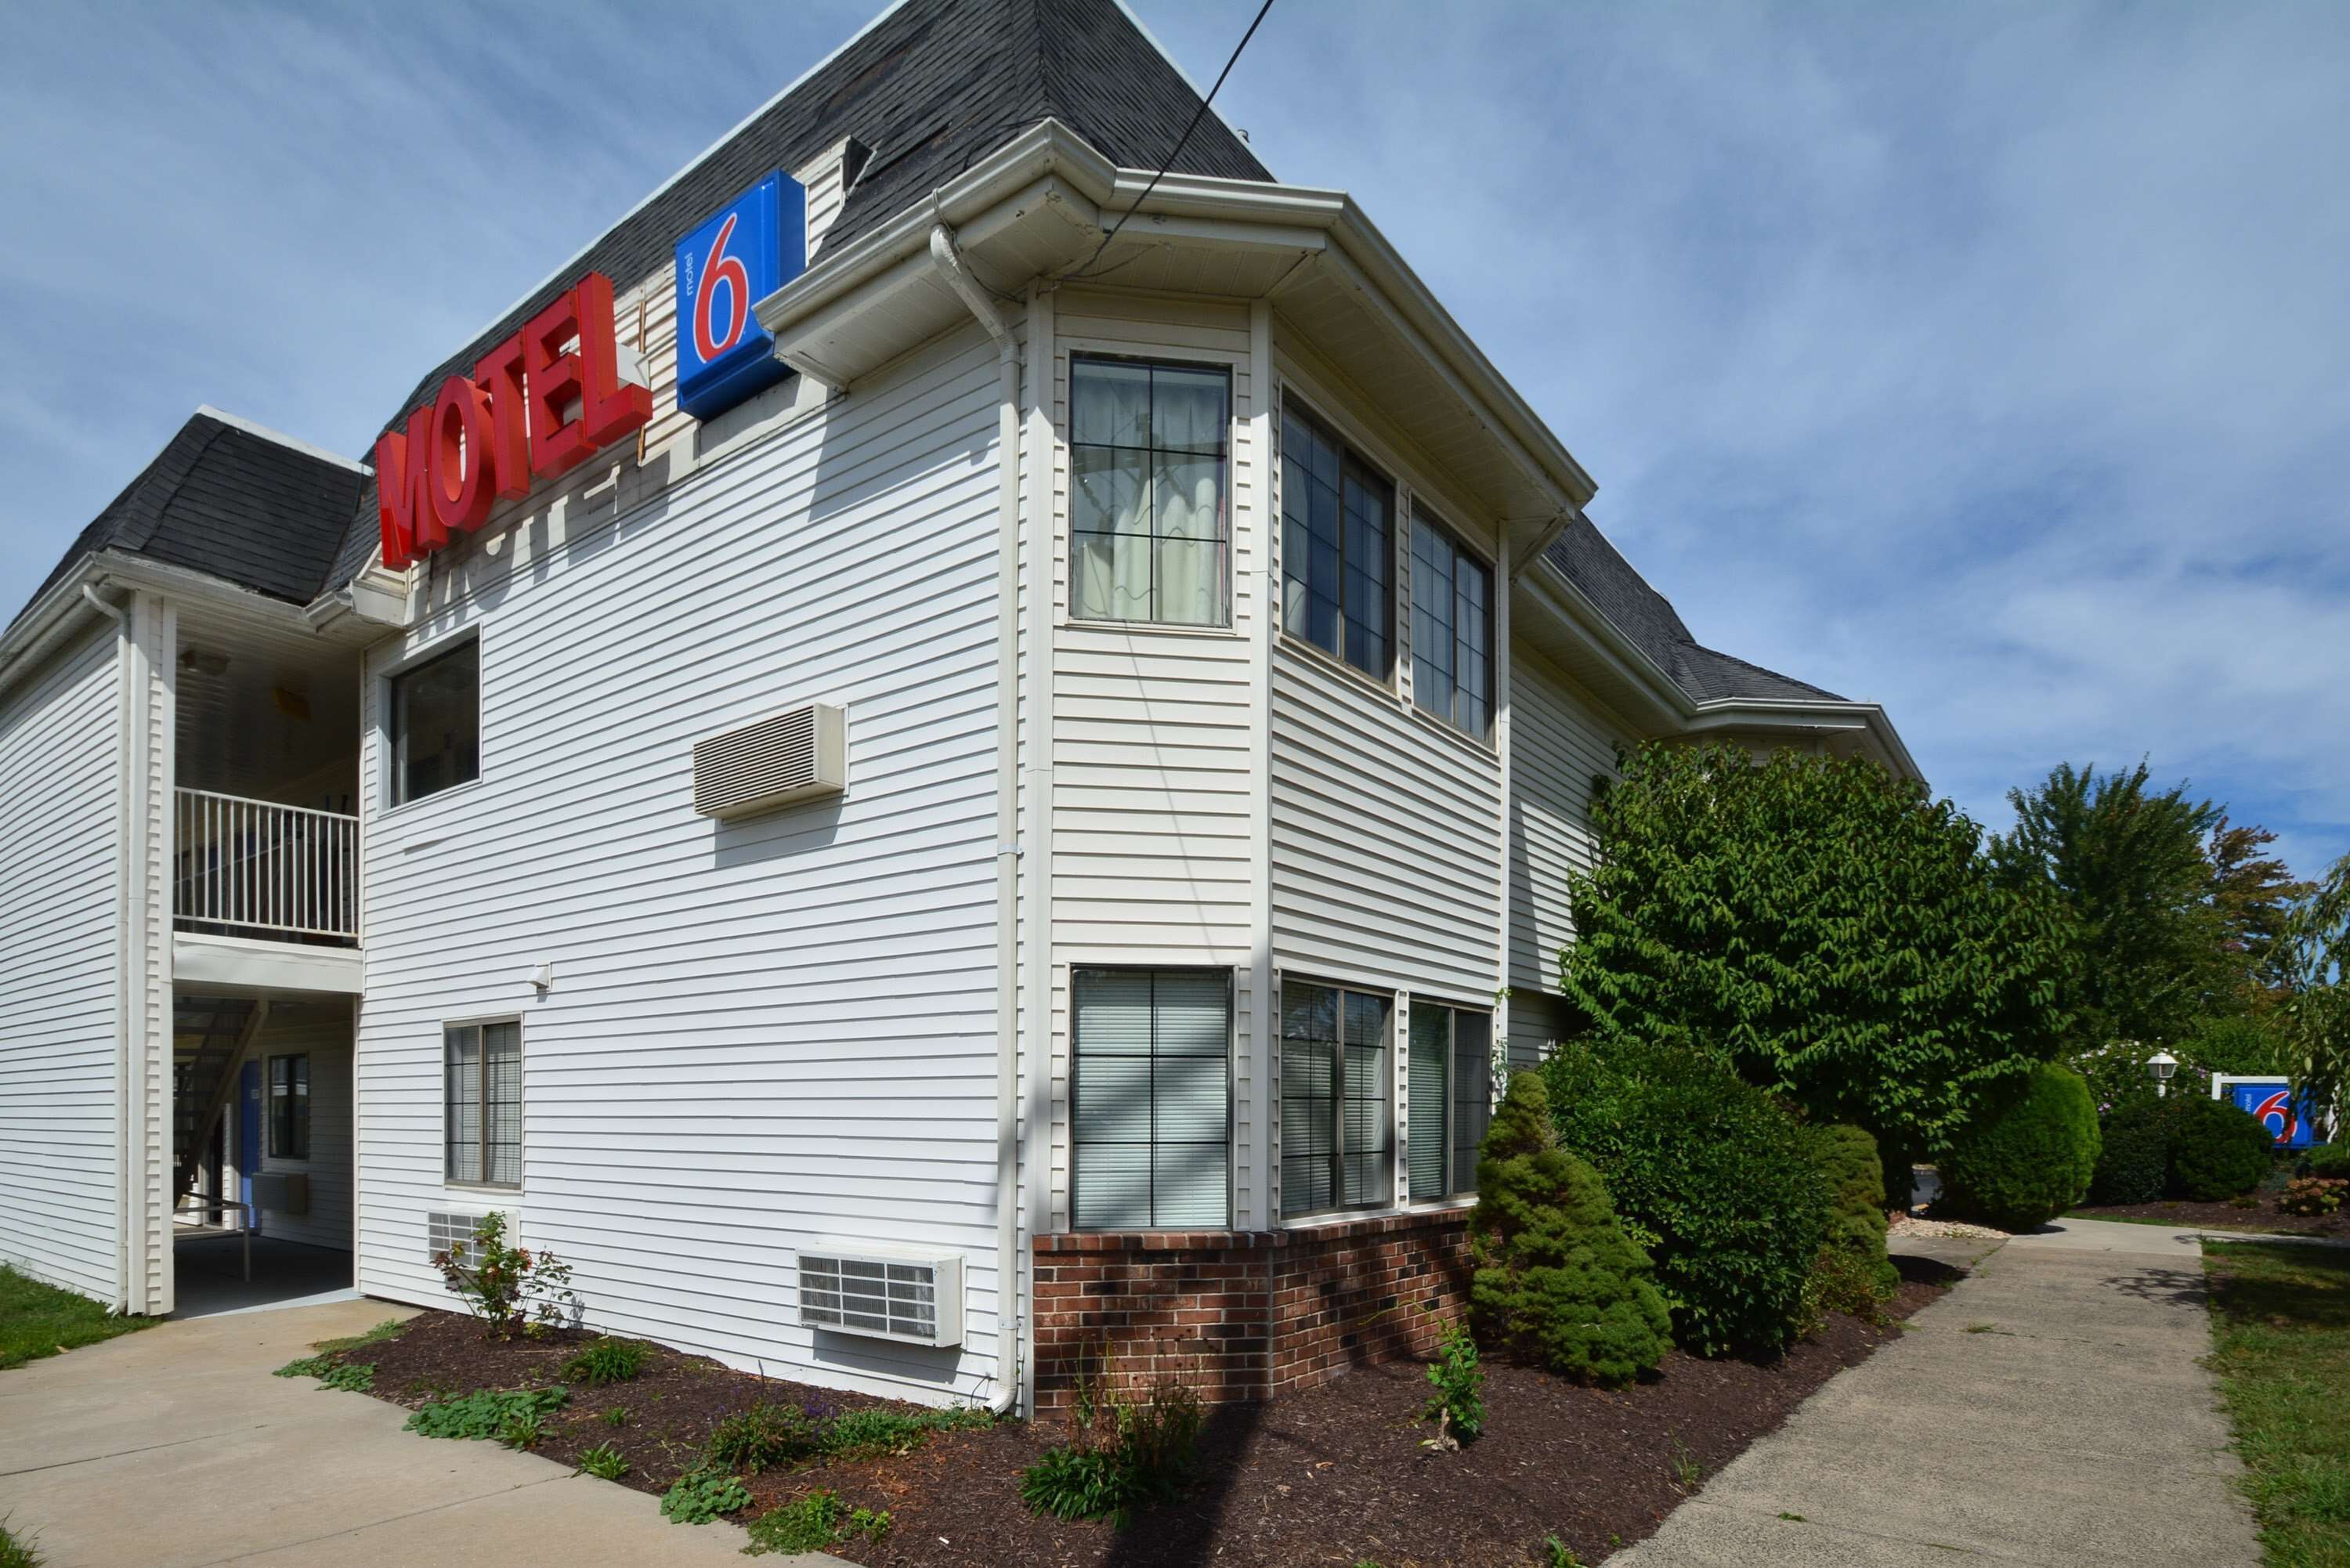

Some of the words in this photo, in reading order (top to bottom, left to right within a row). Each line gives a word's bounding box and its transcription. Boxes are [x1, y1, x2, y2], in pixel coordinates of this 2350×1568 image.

[684, 251, 694, 297] motel
[692, 212, 750, 363] 6
[376, 270, 653, 573] MOTEL
[2252, 1090, 2298, 1144] 6
